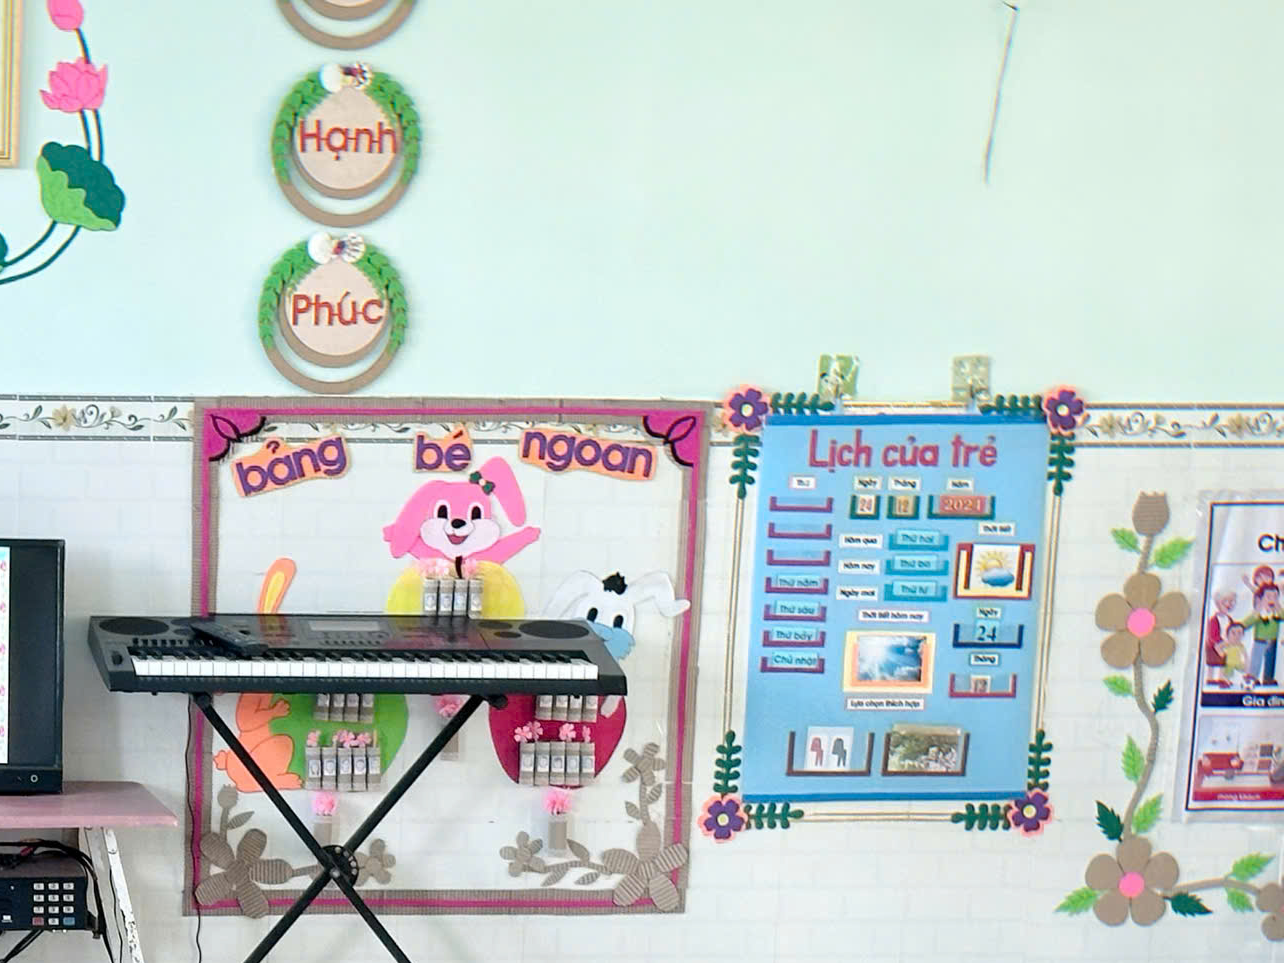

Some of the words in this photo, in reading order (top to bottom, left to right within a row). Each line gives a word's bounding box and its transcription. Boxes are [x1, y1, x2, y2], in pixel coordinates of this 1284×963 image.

[299, 120, 397, 160] Hạnh
[291, 292, 384, 326] Phúc
[236, 436, 347, 495] bảng
[415, 430, 472, 473] bé
[521, 430, 653, 479] ngoan
[809, 429, 872, 473] Lịch
[882, 435, 939, 467] của
[951, 434, 997, 467] trẻ
[977, 625, 996, 641] 24
